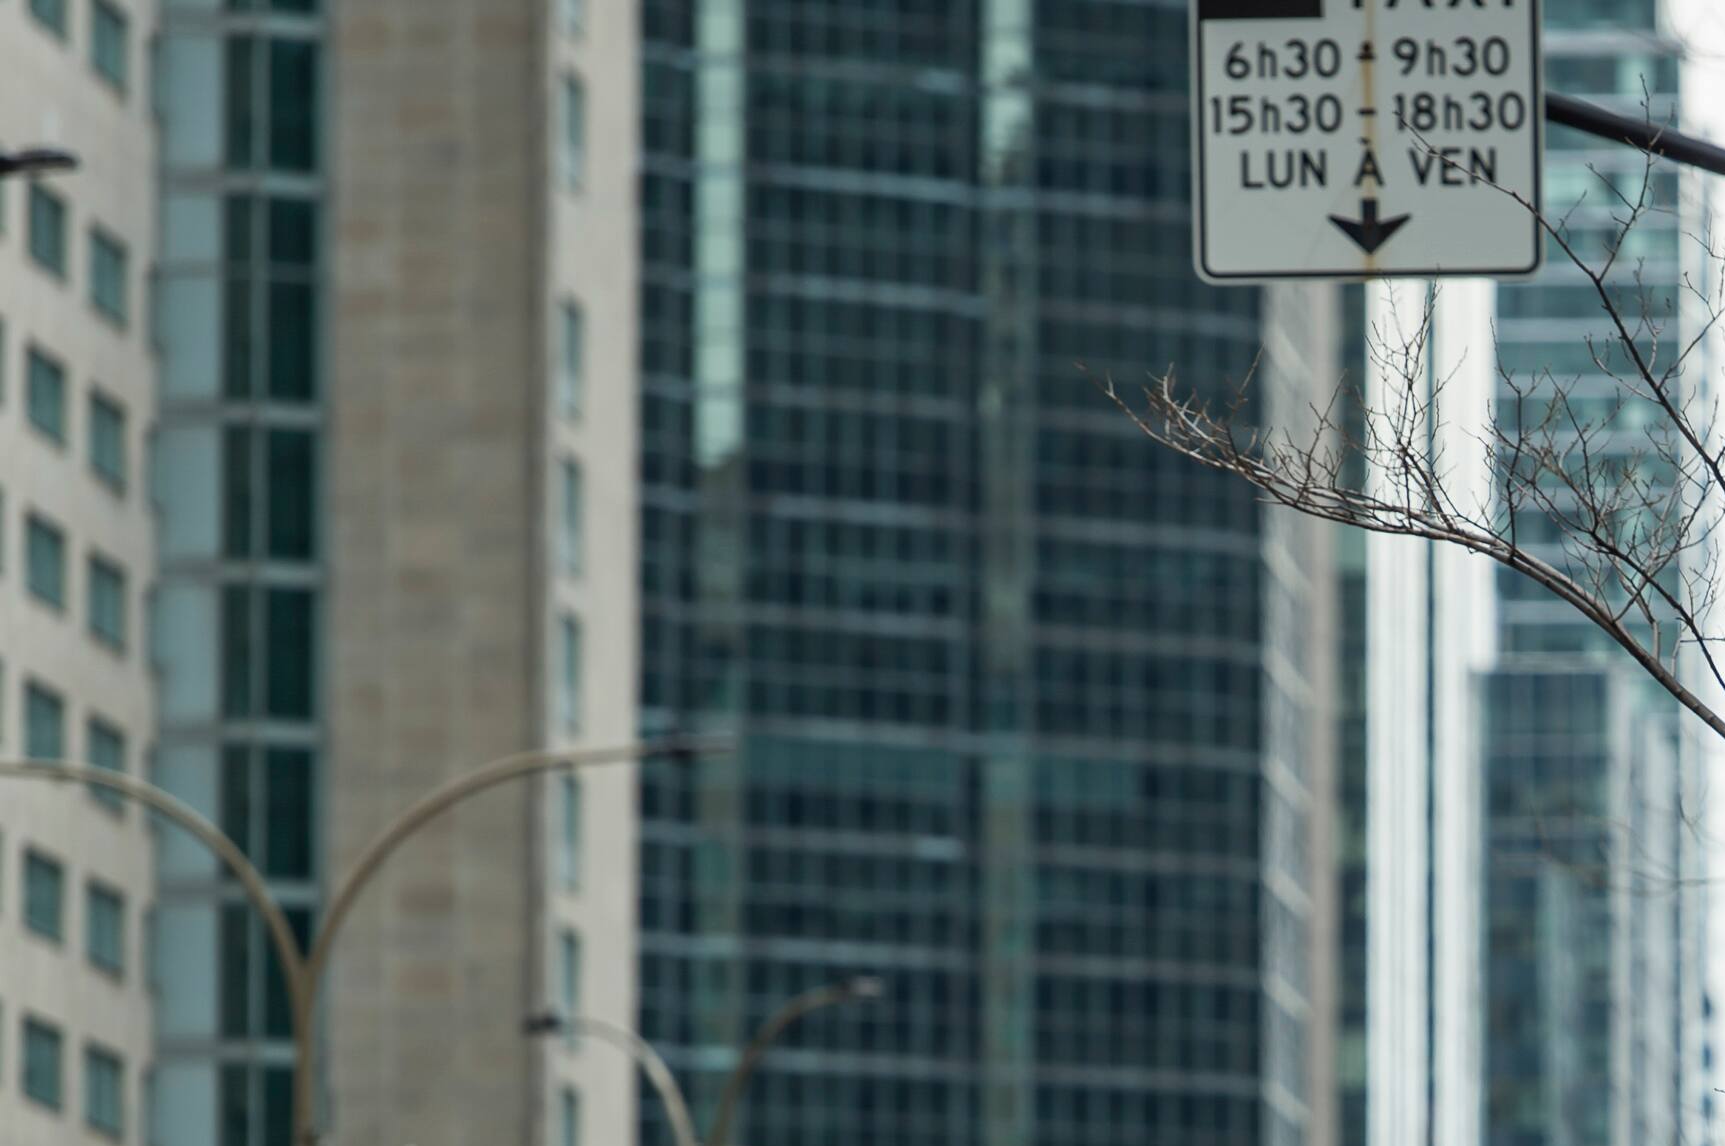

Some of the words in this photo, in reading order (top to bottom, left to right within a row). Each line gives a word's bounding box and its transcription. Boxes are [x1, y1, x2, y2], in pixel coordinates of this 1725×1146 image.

[1225, 39, 1342, 80] 6h30
[1392, 36, 1511, 77] 9h30
[1211, 96, 1343, 135] 15h30
[1394, 91, 1526, 132] 18h30
[1240, 149, 1327, 189] LUN
[1353, 138, 1384, 188] À
[1408, 147, 1498, 187] VEN
